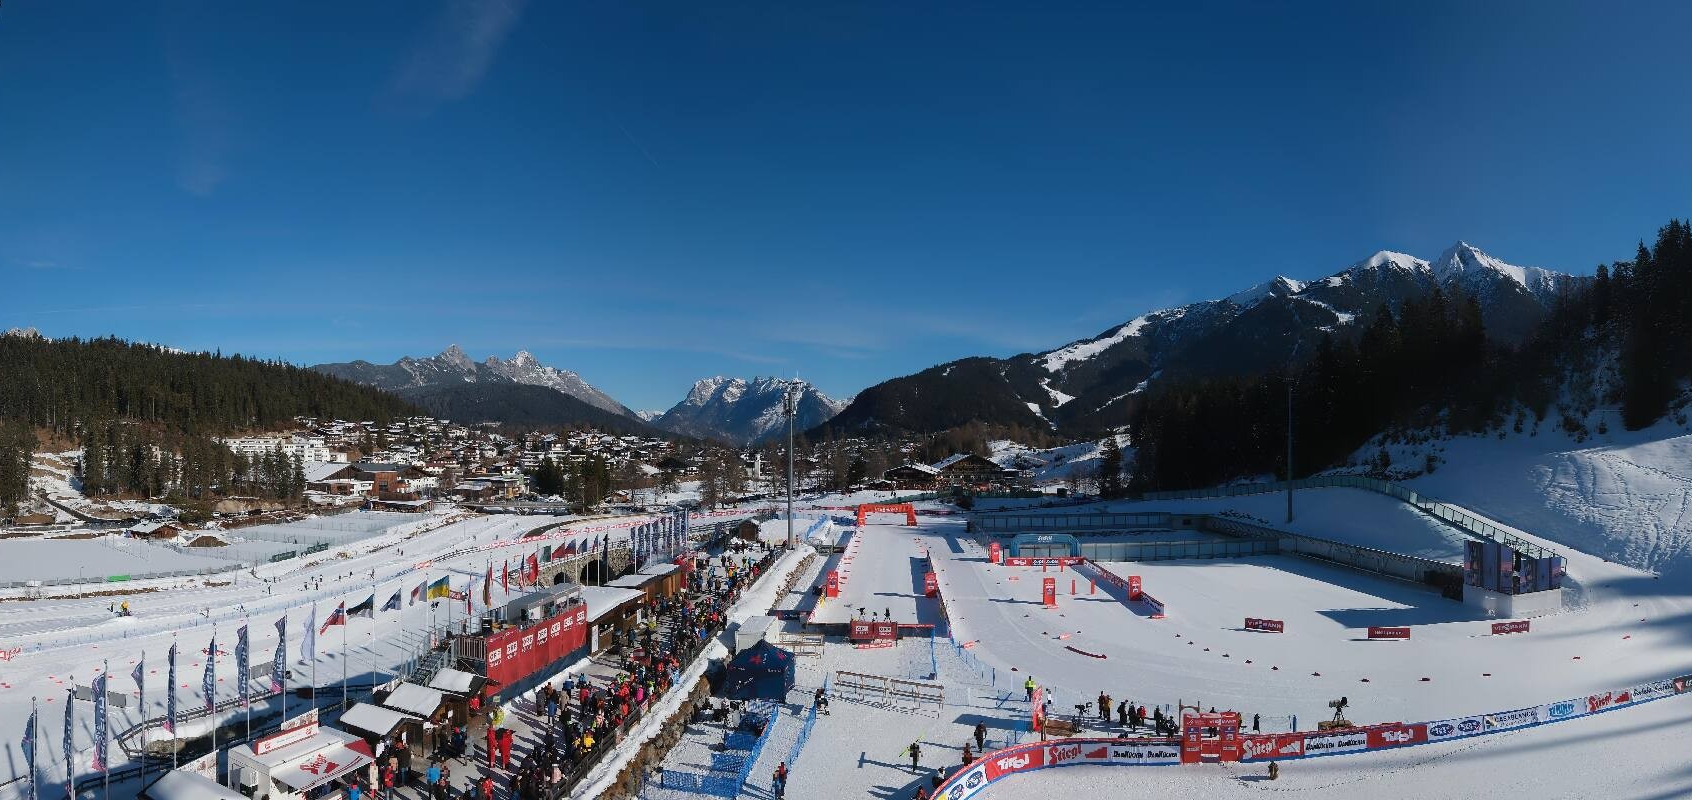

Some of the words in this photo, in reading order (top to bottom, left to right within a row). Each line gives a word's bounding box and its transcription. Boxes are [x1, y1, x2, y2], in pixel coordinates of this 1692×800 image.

[1495, 711, 1535, 723] CASABLANCA
[1049, 743, 1082, 766] Stiegl
[1243, 739, 1277, 760] Stiegl
[997, 754, 1030, 770] Tirol
